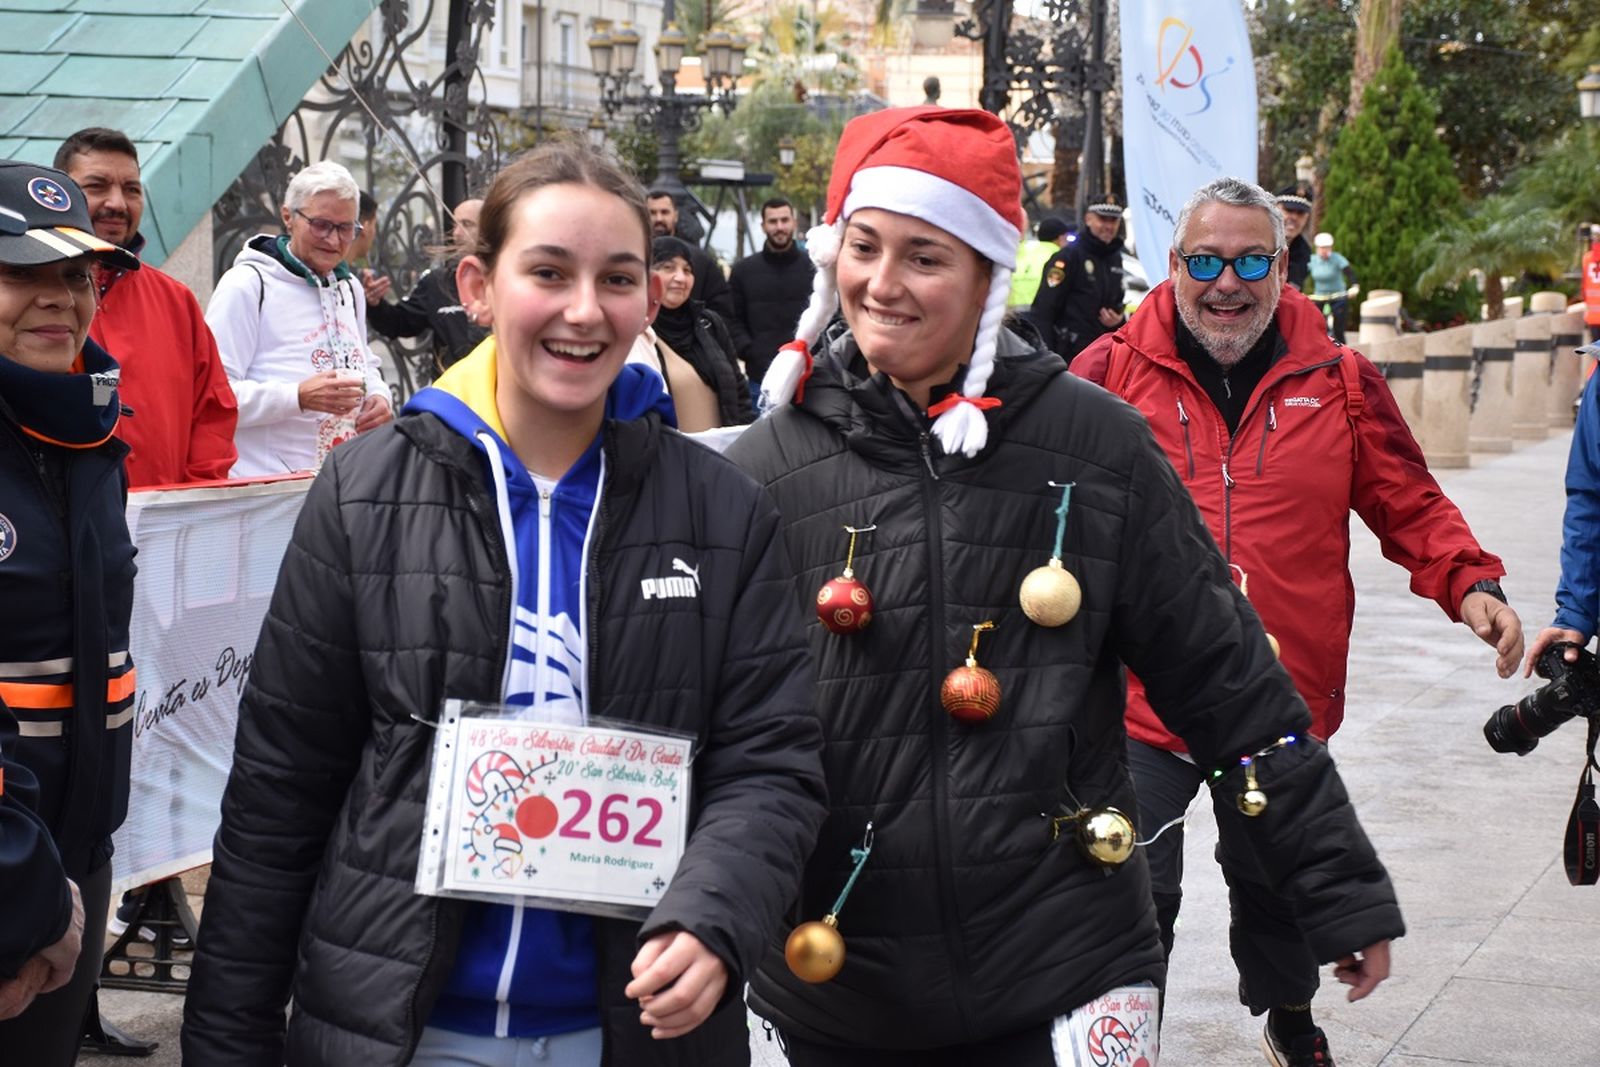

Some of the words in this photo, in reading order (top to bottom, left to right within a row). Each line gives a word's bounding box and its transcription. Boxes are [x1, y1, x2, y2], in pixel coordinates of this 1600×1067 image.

[641, 576, 697, 600] PUMA
[192, 676, 211, 702] es
[559, 789, 662, 848] 262
[1584, 832, 1596, 870] Canon
